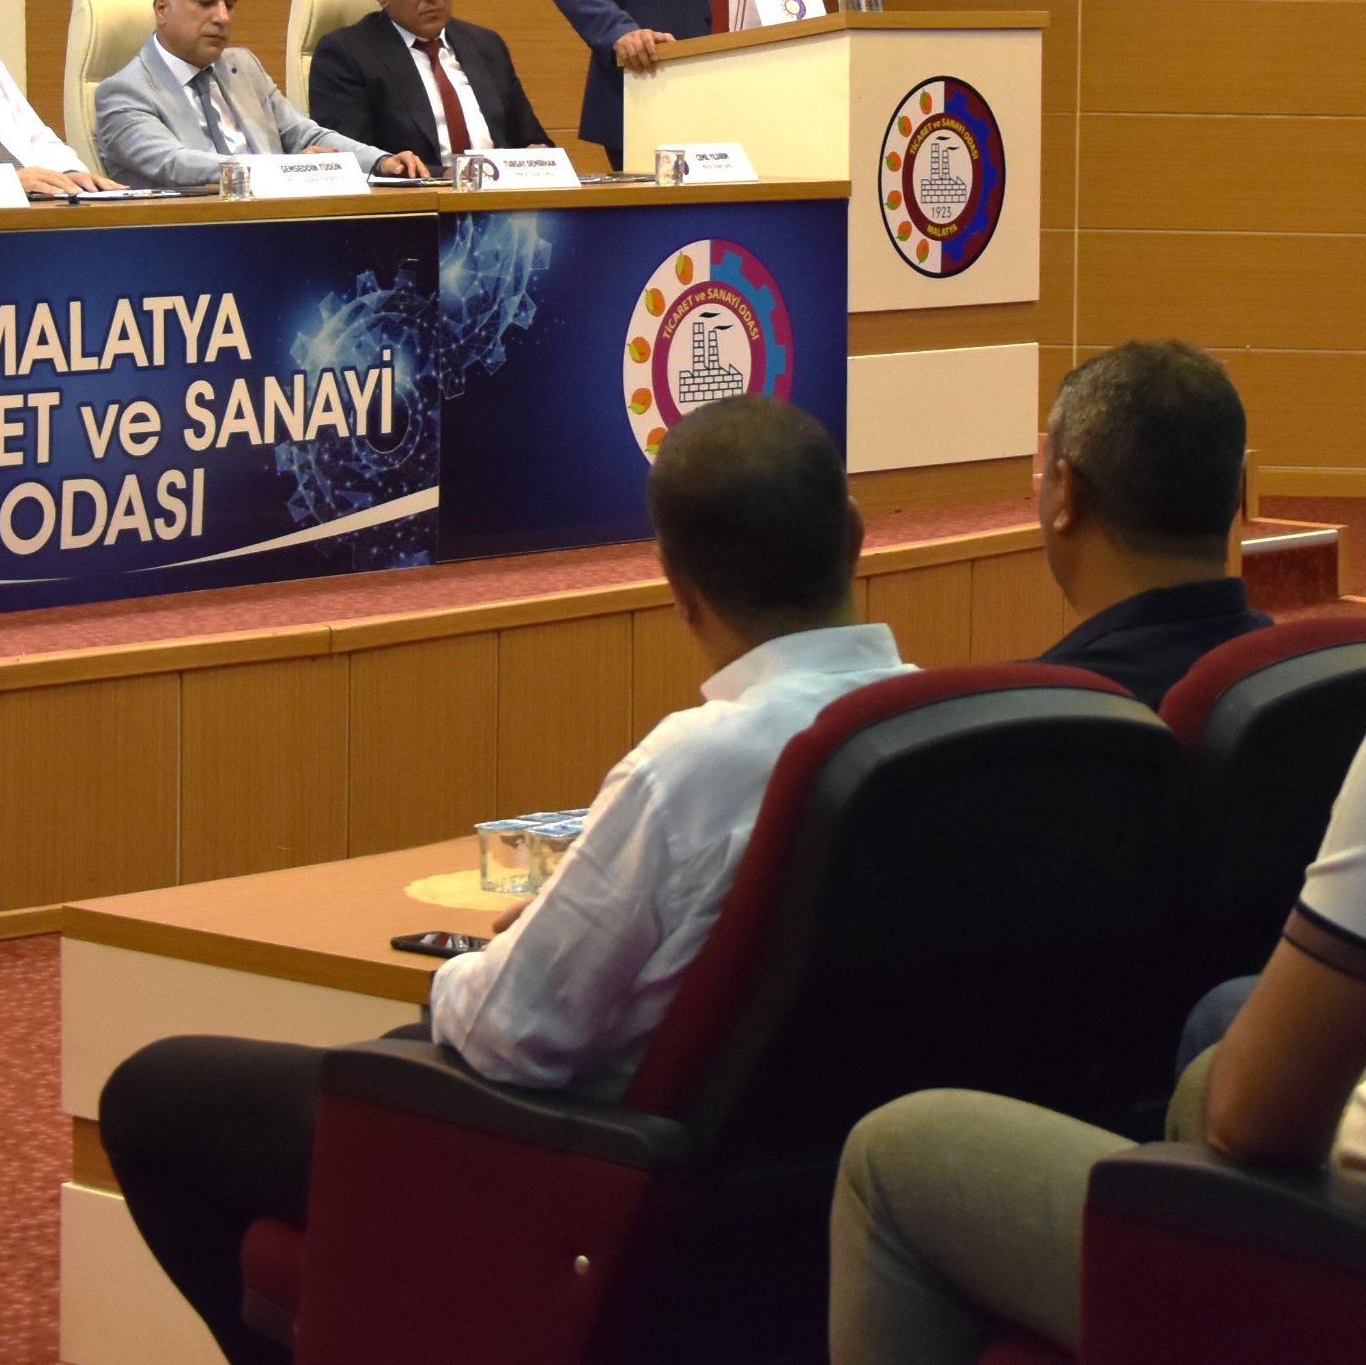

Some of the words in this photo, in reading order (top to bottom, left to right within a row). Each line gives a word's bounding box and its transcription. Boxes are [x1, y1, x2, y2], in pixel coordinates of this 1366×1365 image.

[909, 122, 933, 155] TİCARET
[931, 206, 952, 219] 1923
[926, 223, 958, 236] MALATYA
[662, 297, 694, 340] TİCARET
[695, 290, 707, 302] ve
[707, 287, 741, 309] SANAYİ
[738, 303, 760, 341] ODASI
[80, 400, 162, 460] ve
[183, 349, 394, 452] SANAYİ
